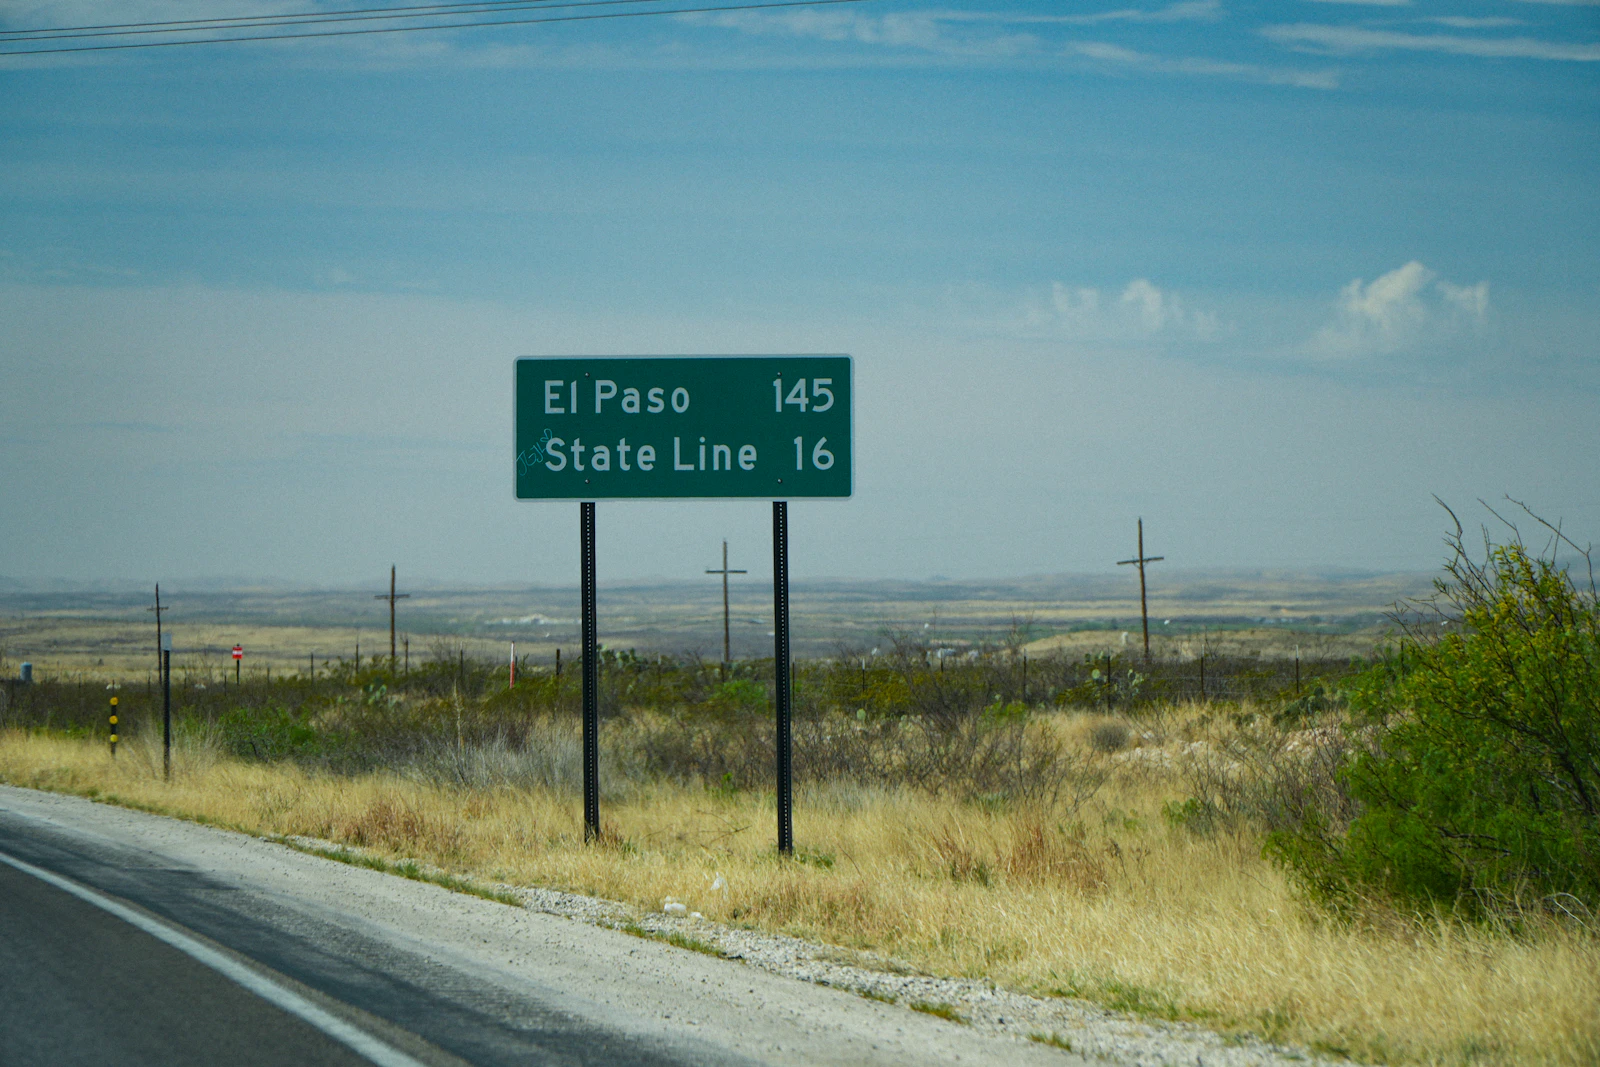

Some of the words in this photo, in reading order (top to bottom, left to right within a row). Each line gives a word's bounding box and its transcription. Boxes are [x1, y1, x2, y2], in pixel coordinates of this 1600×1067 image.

[545, 379, 577, 414] El
[595, 379, 690, 414] Paso
[772, 378, 835, 413] 145
[545, 437, 657, 472] State
[674, 436, 758, 471] Line
[793, 436, 835, 471] 16
